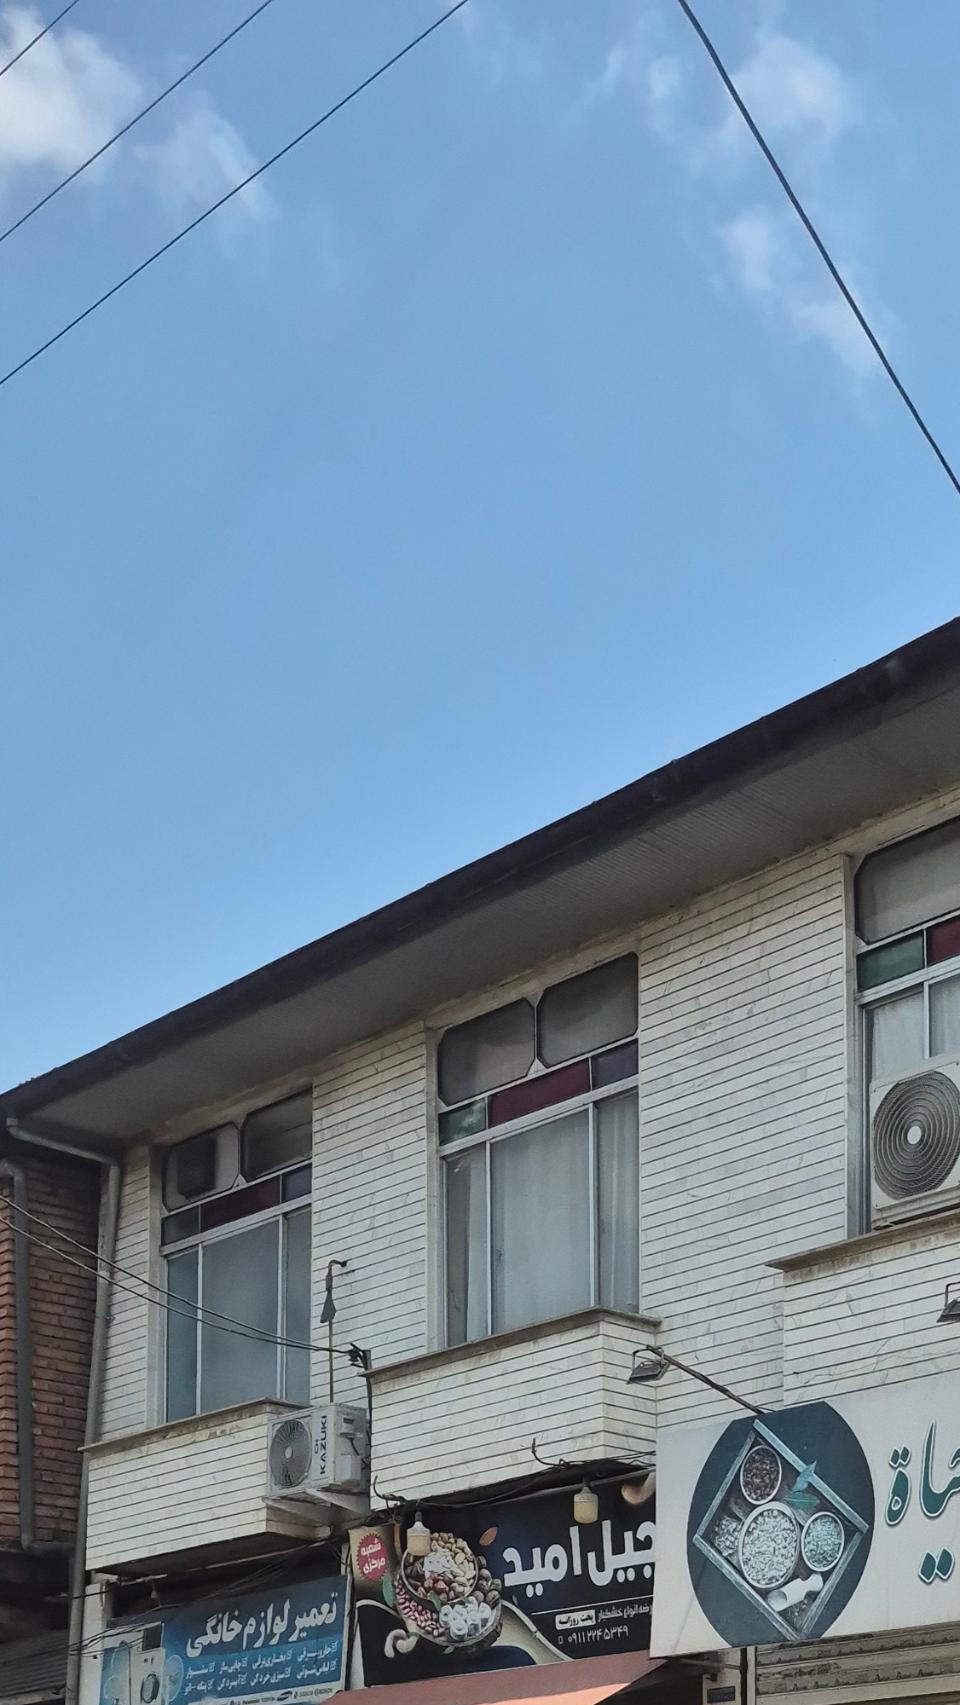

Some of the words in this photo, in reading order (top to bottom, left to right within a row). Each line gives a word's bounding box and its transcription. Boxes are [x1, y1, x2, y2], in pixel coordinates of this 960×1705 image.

[319, 1414, 328, 1475] KAZUKI
[360, 1537, 382, 1557] شعبه
[362, 1557, 386, 1575] مرکزی
[502, 1525, 583, 1598] امید
[587, 1519, 657, 1588] جیل
[186, 1608, 243, 1658] خانگی
[242, 1599, 291, 1650] لوازم
[287, 1591, 339, 1642] تعمیر
